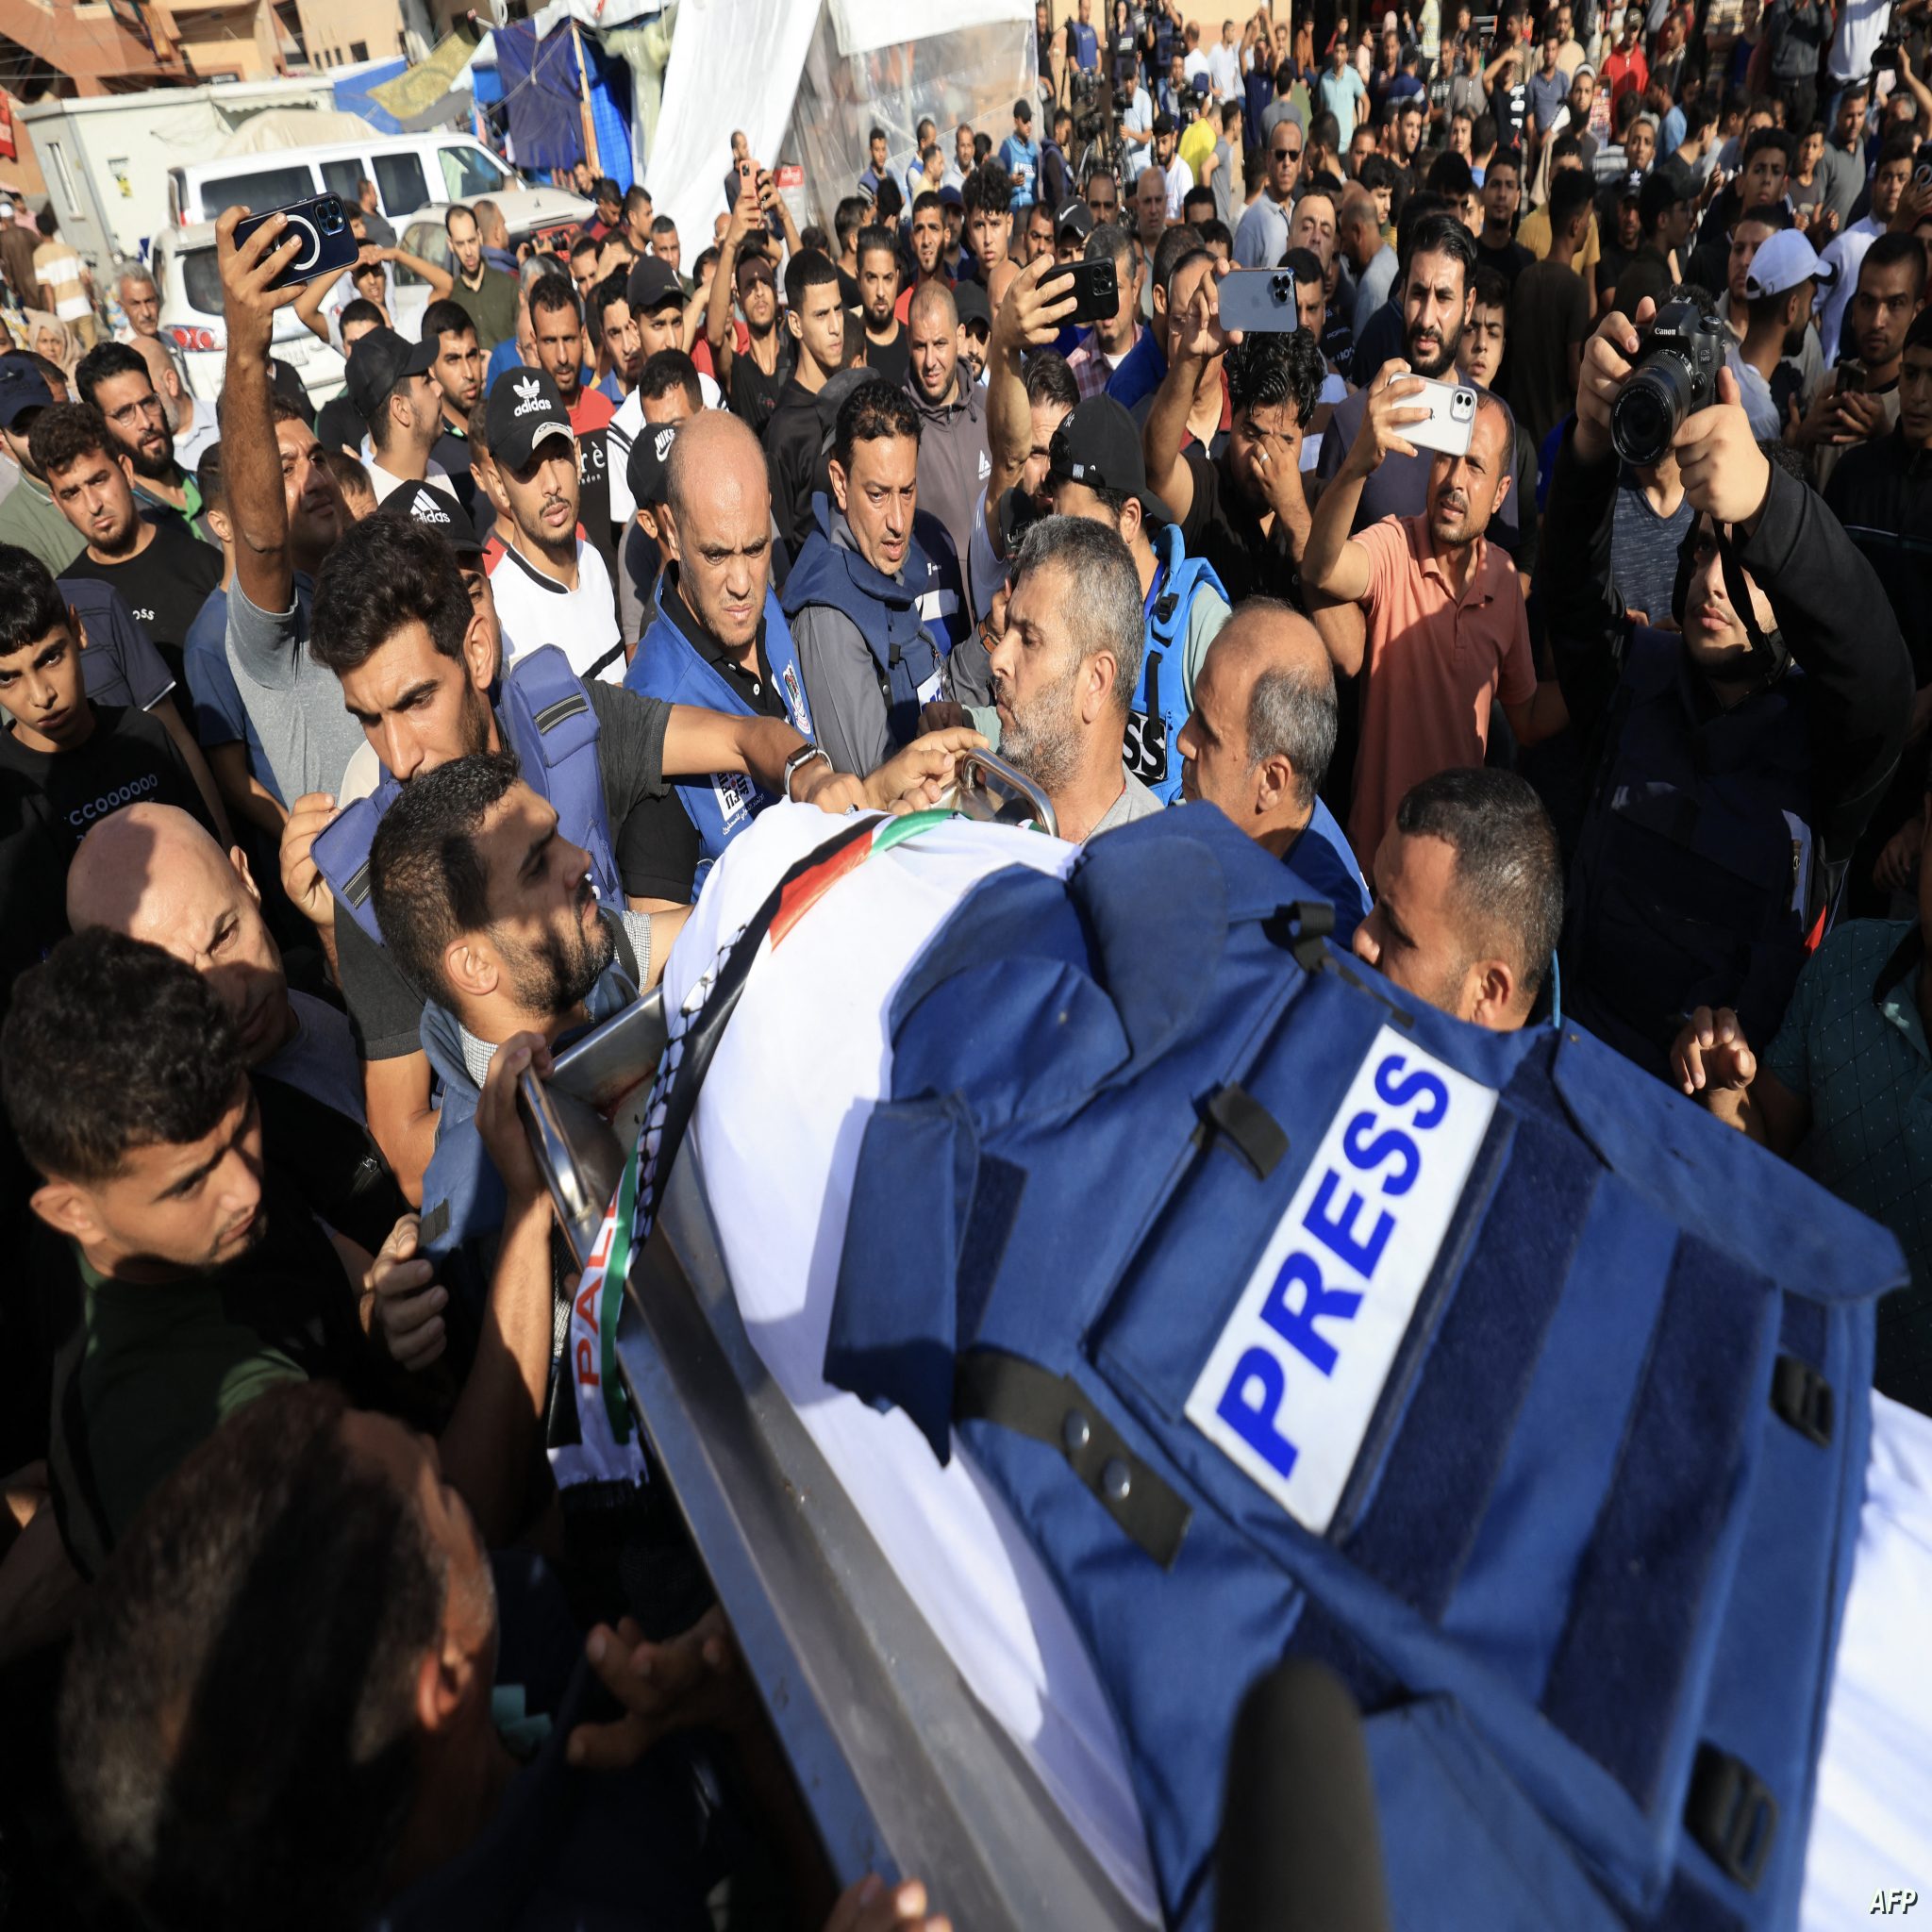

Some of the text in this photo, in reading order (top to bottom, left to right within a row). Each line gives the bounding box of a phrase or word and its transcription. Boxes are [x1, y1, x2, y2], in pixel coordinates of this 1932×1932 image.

[1655, 327, 1676, 336] Canon
[514, 396, 552, 417] adidas
[412, 509, 451, 524] idas
[1216, 1054, 1450, 1480] PRESS
